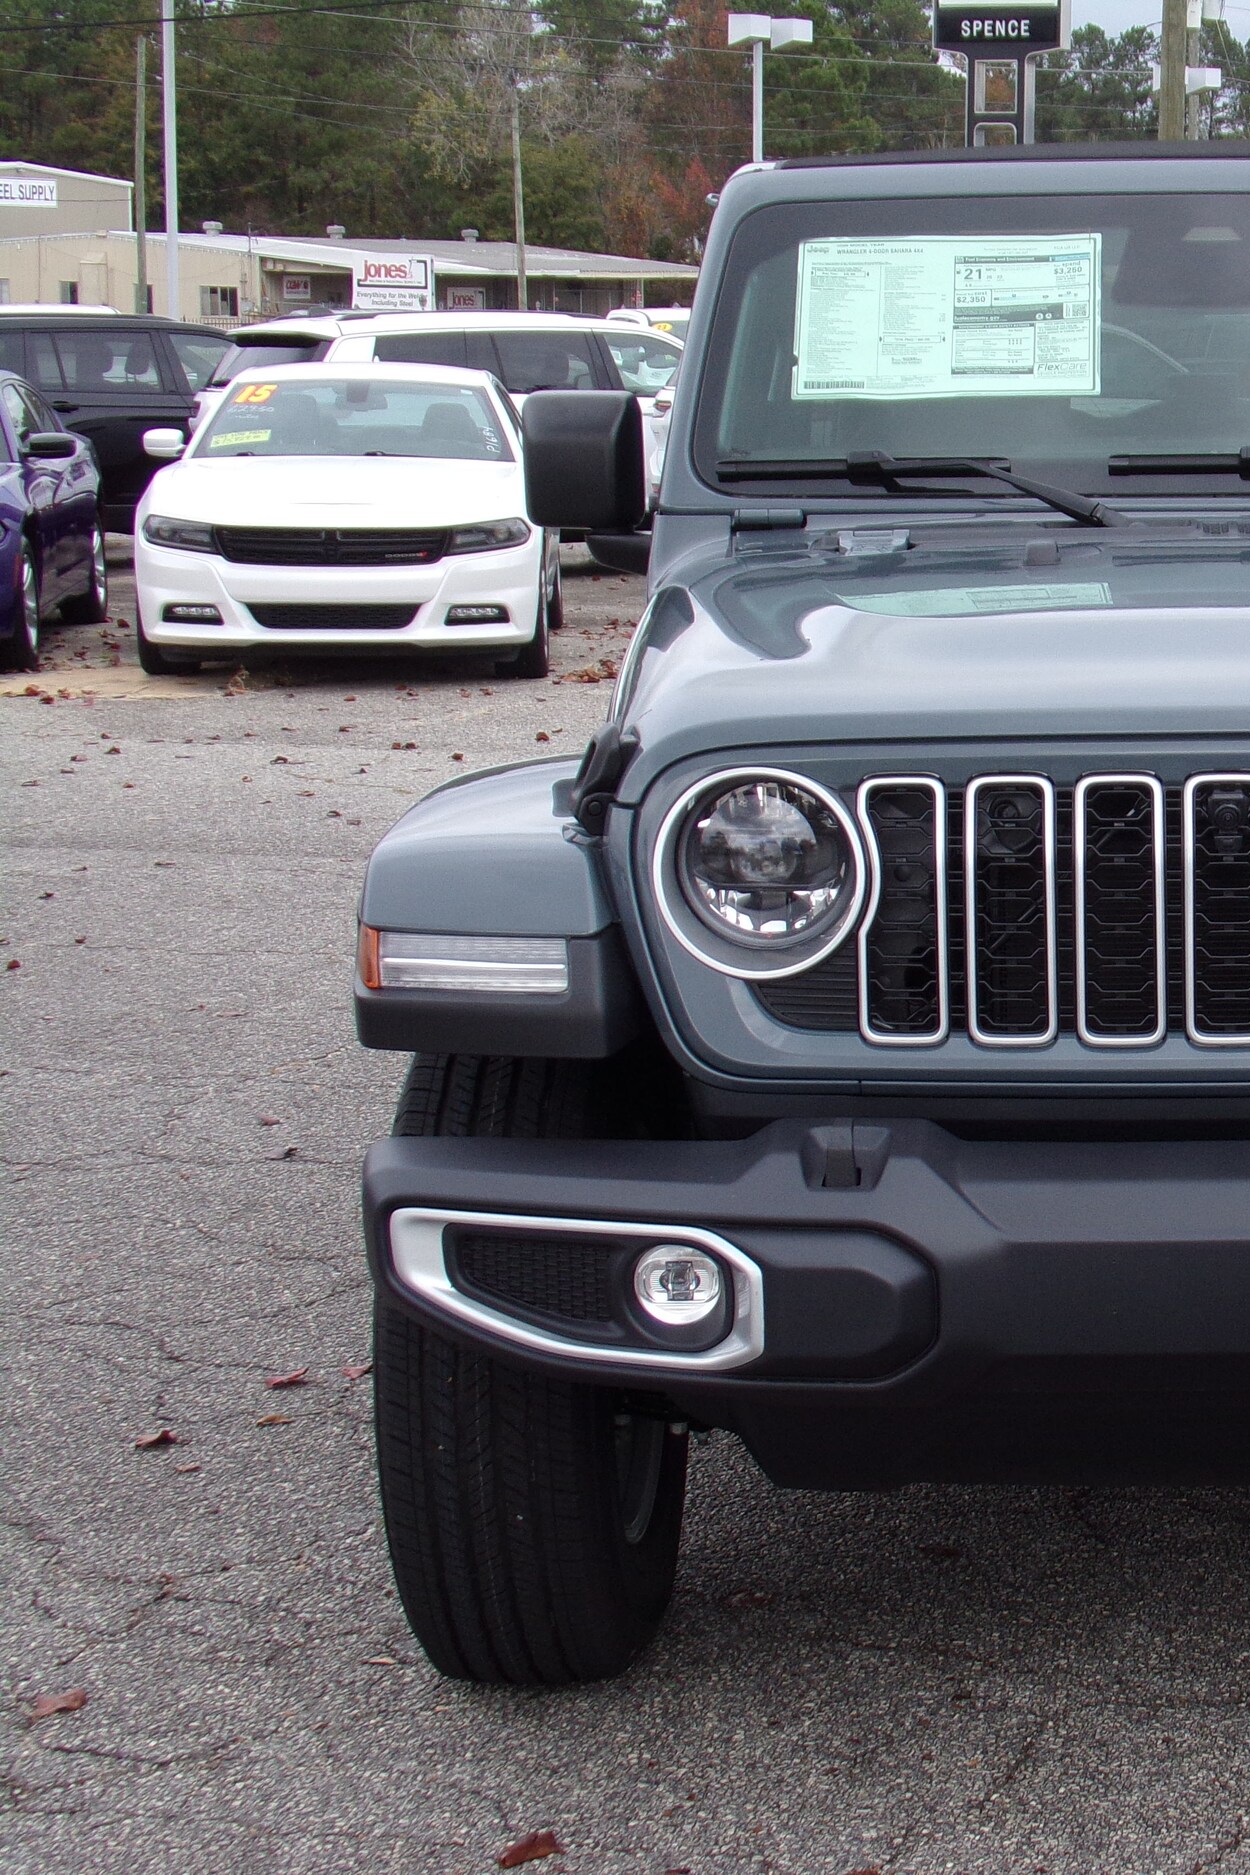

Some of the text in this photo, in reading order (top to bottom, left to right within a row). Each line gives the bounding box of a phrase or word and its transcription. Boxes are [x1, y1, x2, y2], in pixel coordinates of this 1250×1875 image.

[961, 19, 1030, 37] SPENCE
[18, 184, 54, 201] SUPPLY
[964, 268, 982, 280] 21
[1054, 267, 1083, 275] $3,250
[357, 291, 388, 300] Everything
[956, 296, 986, 304] $2,350
[371, 299, 398, 308] Including
[1038, 363, 1087, 371] FlexCare
[231, 384, 279, 405] 15
